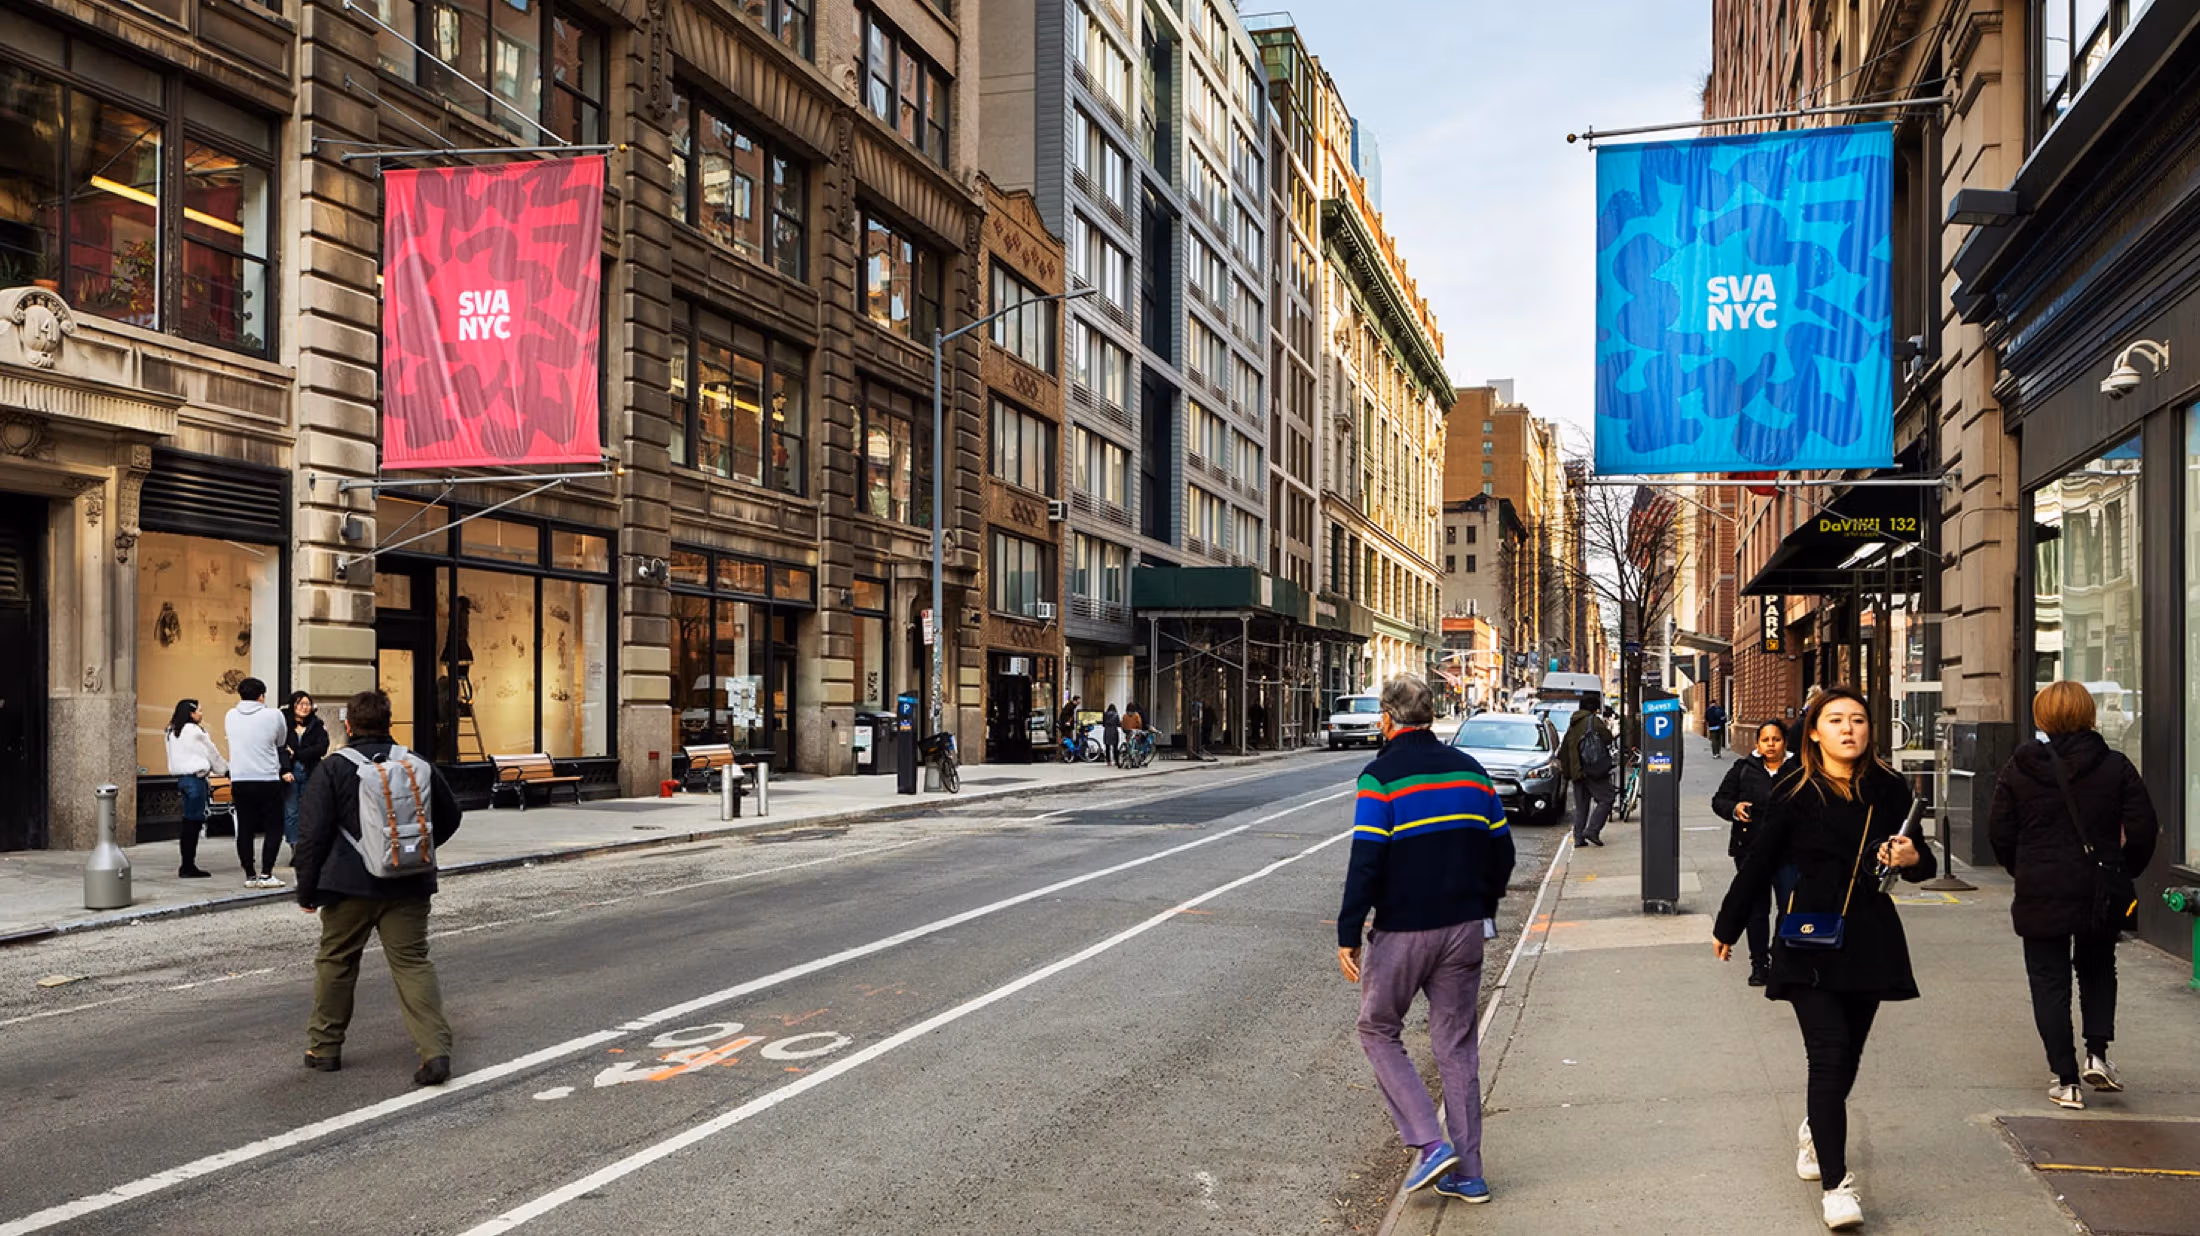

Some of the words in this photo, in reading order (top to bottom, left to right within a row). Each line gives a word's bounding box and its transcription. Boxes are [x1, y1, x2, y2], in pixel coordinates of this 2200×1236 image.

[1707, 273, 1777, 304] SVA
[459, 289, 510, 316] SVA
[459, 314, 511, 341] NYC
[1707, 302, 1777, 331] NYC
[1889, 517, 1916, 531] 132
[1765, 595, 1779, 638] PARK
[1655, 716, 1668, 736] P
